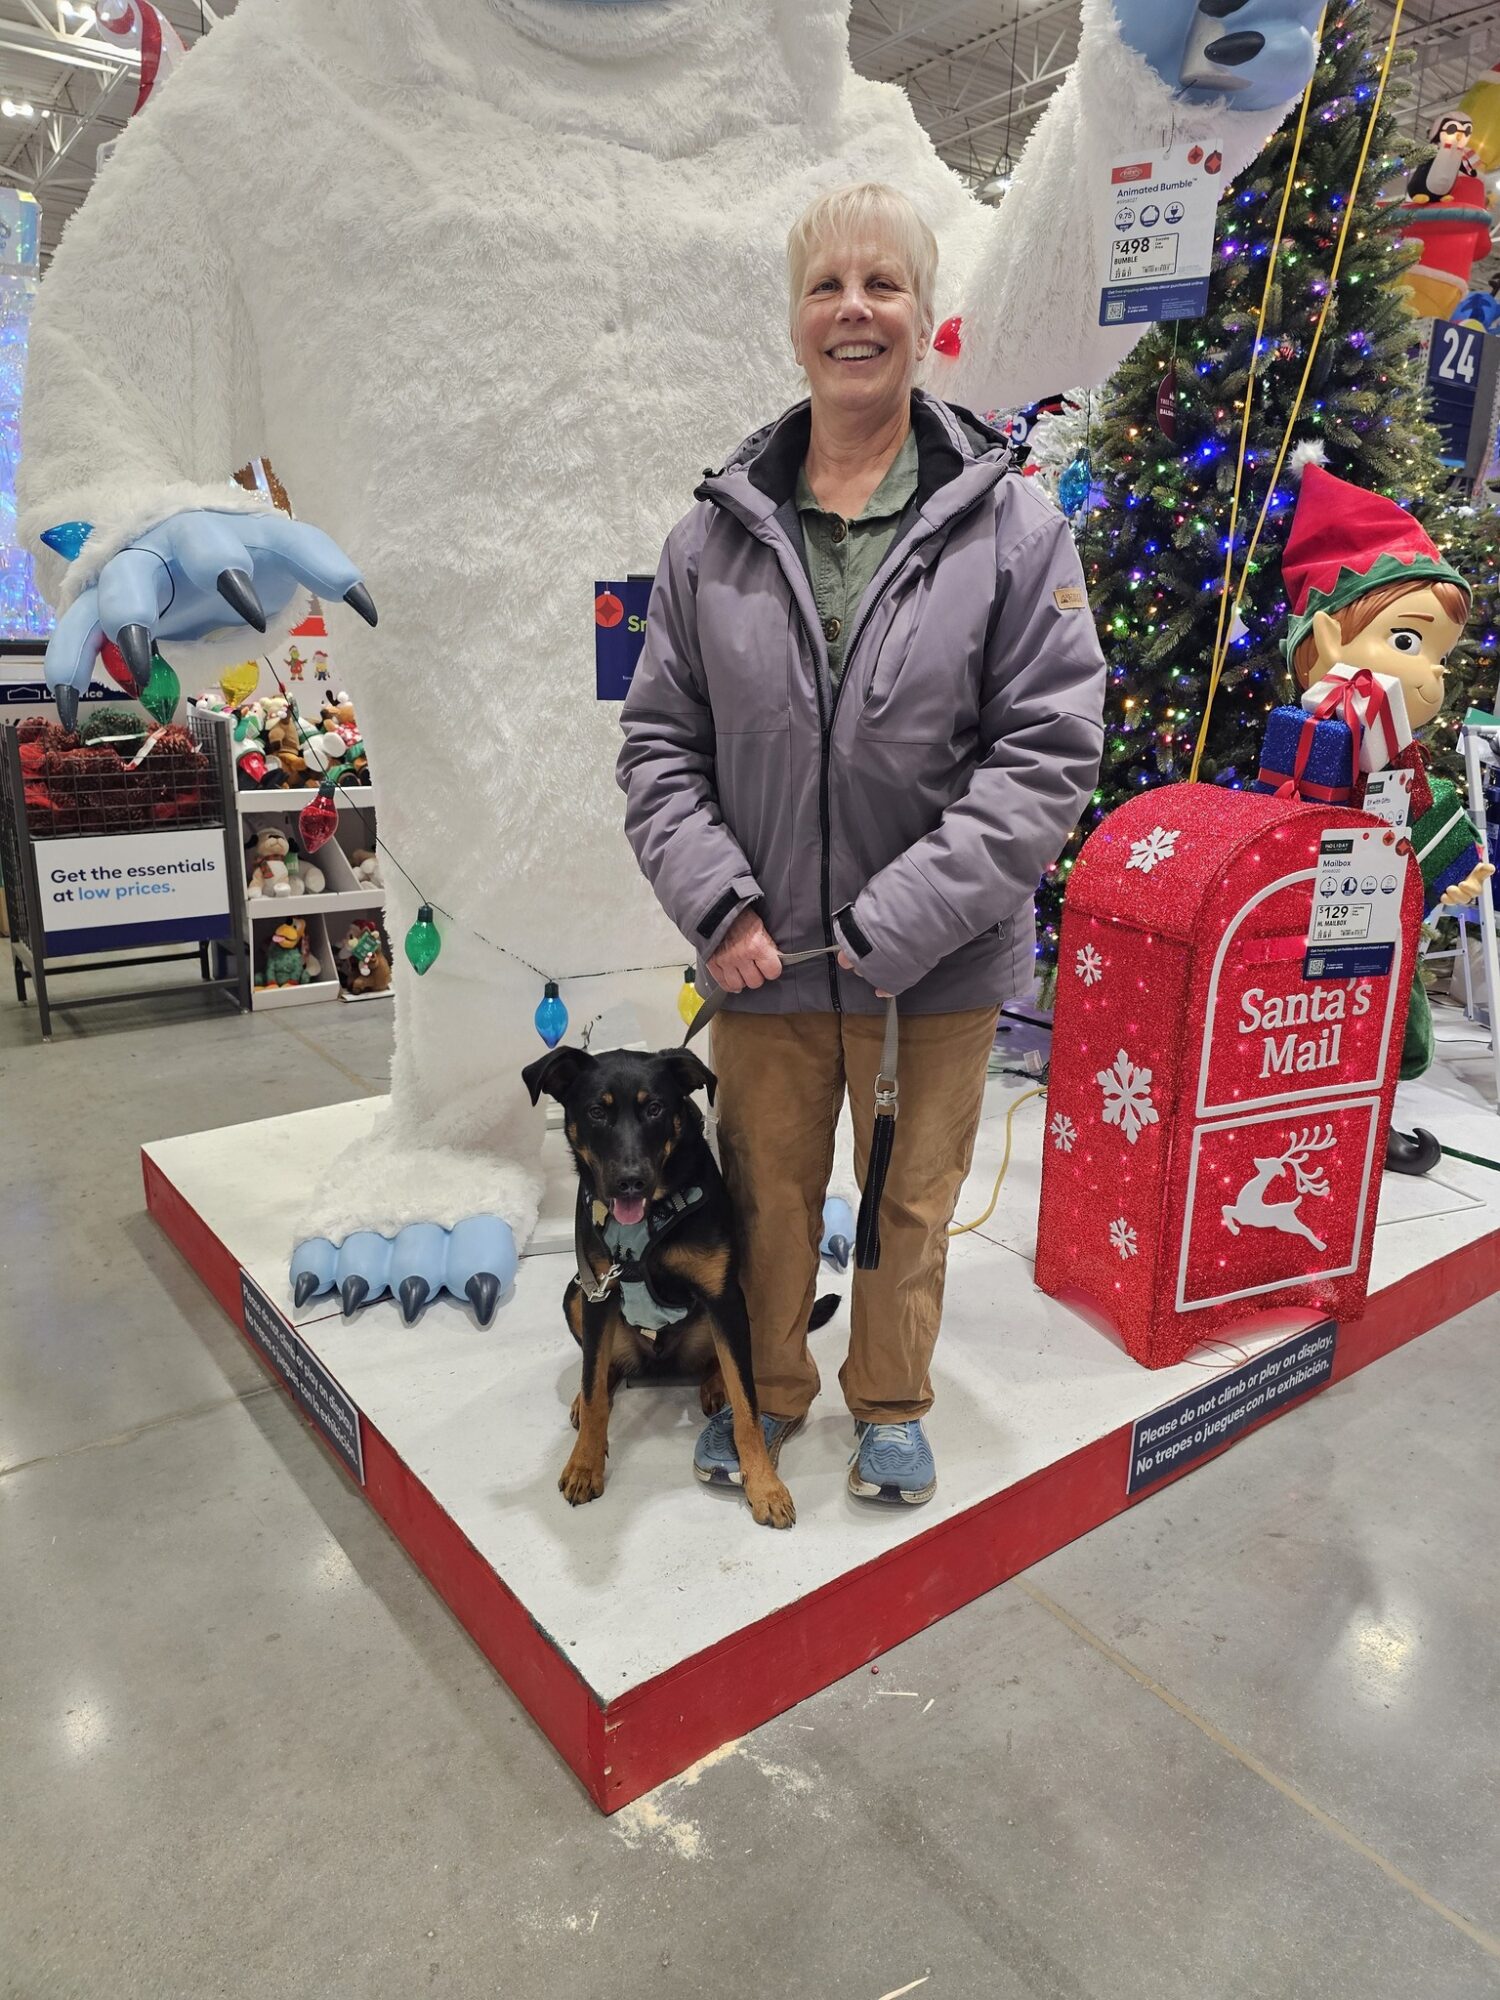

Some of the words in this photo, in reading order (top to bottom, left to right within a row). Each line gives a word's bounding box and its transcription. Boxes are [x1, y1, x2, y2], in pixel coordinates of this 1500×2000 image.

[1116, 184, 1158, 198] Animated
[1116, 238, 1150, 254] $498
[1114, 256, 1138, 265] BUMBLE
[1438, 328, 1474, 384] 24
[51, 869, 87, 884] Get
[90, 865, 123, 881] the
[126, 857, 215, 879] essentials
[52, 889, 75, 903] at
[78, 885, 112, 902] low
[115, 880, 176, 904] prices.
[1320, 906, 1348, 919] $129
[1238, 978, 1372, 1034] Santa's
[1258, 1024, 1342, 1078] Mail
[242, 1282, 262, 1315] Please
[244, 1307, 253, 1326] No
[1139, 1418, 1177, 1447] Please
[1180, 1407, 1195, 1426] do
[1197, 1398, 1217, 1418] not
[1218, 1382, 1246, 1404] climb
[1247, 1374, 1258, 1388] or
[1259, 1361, 1282, 1385] play
[1283, 1356, 1296, 1369] on
[1298, 1335, 1333, 1359] display.
[1136, 1457, 1153, 1476] No
[1155, 1434, 1192, 1463] trepes
[1194, 1431, 1201, 1443] o
[1202, 1406, 1245, 1442] juegues
[1246, 1395, 1264, 1412] con
[1266, 1387, 1276, 1402] la
[1277, 1360, 1329, 1394] exhibición.
